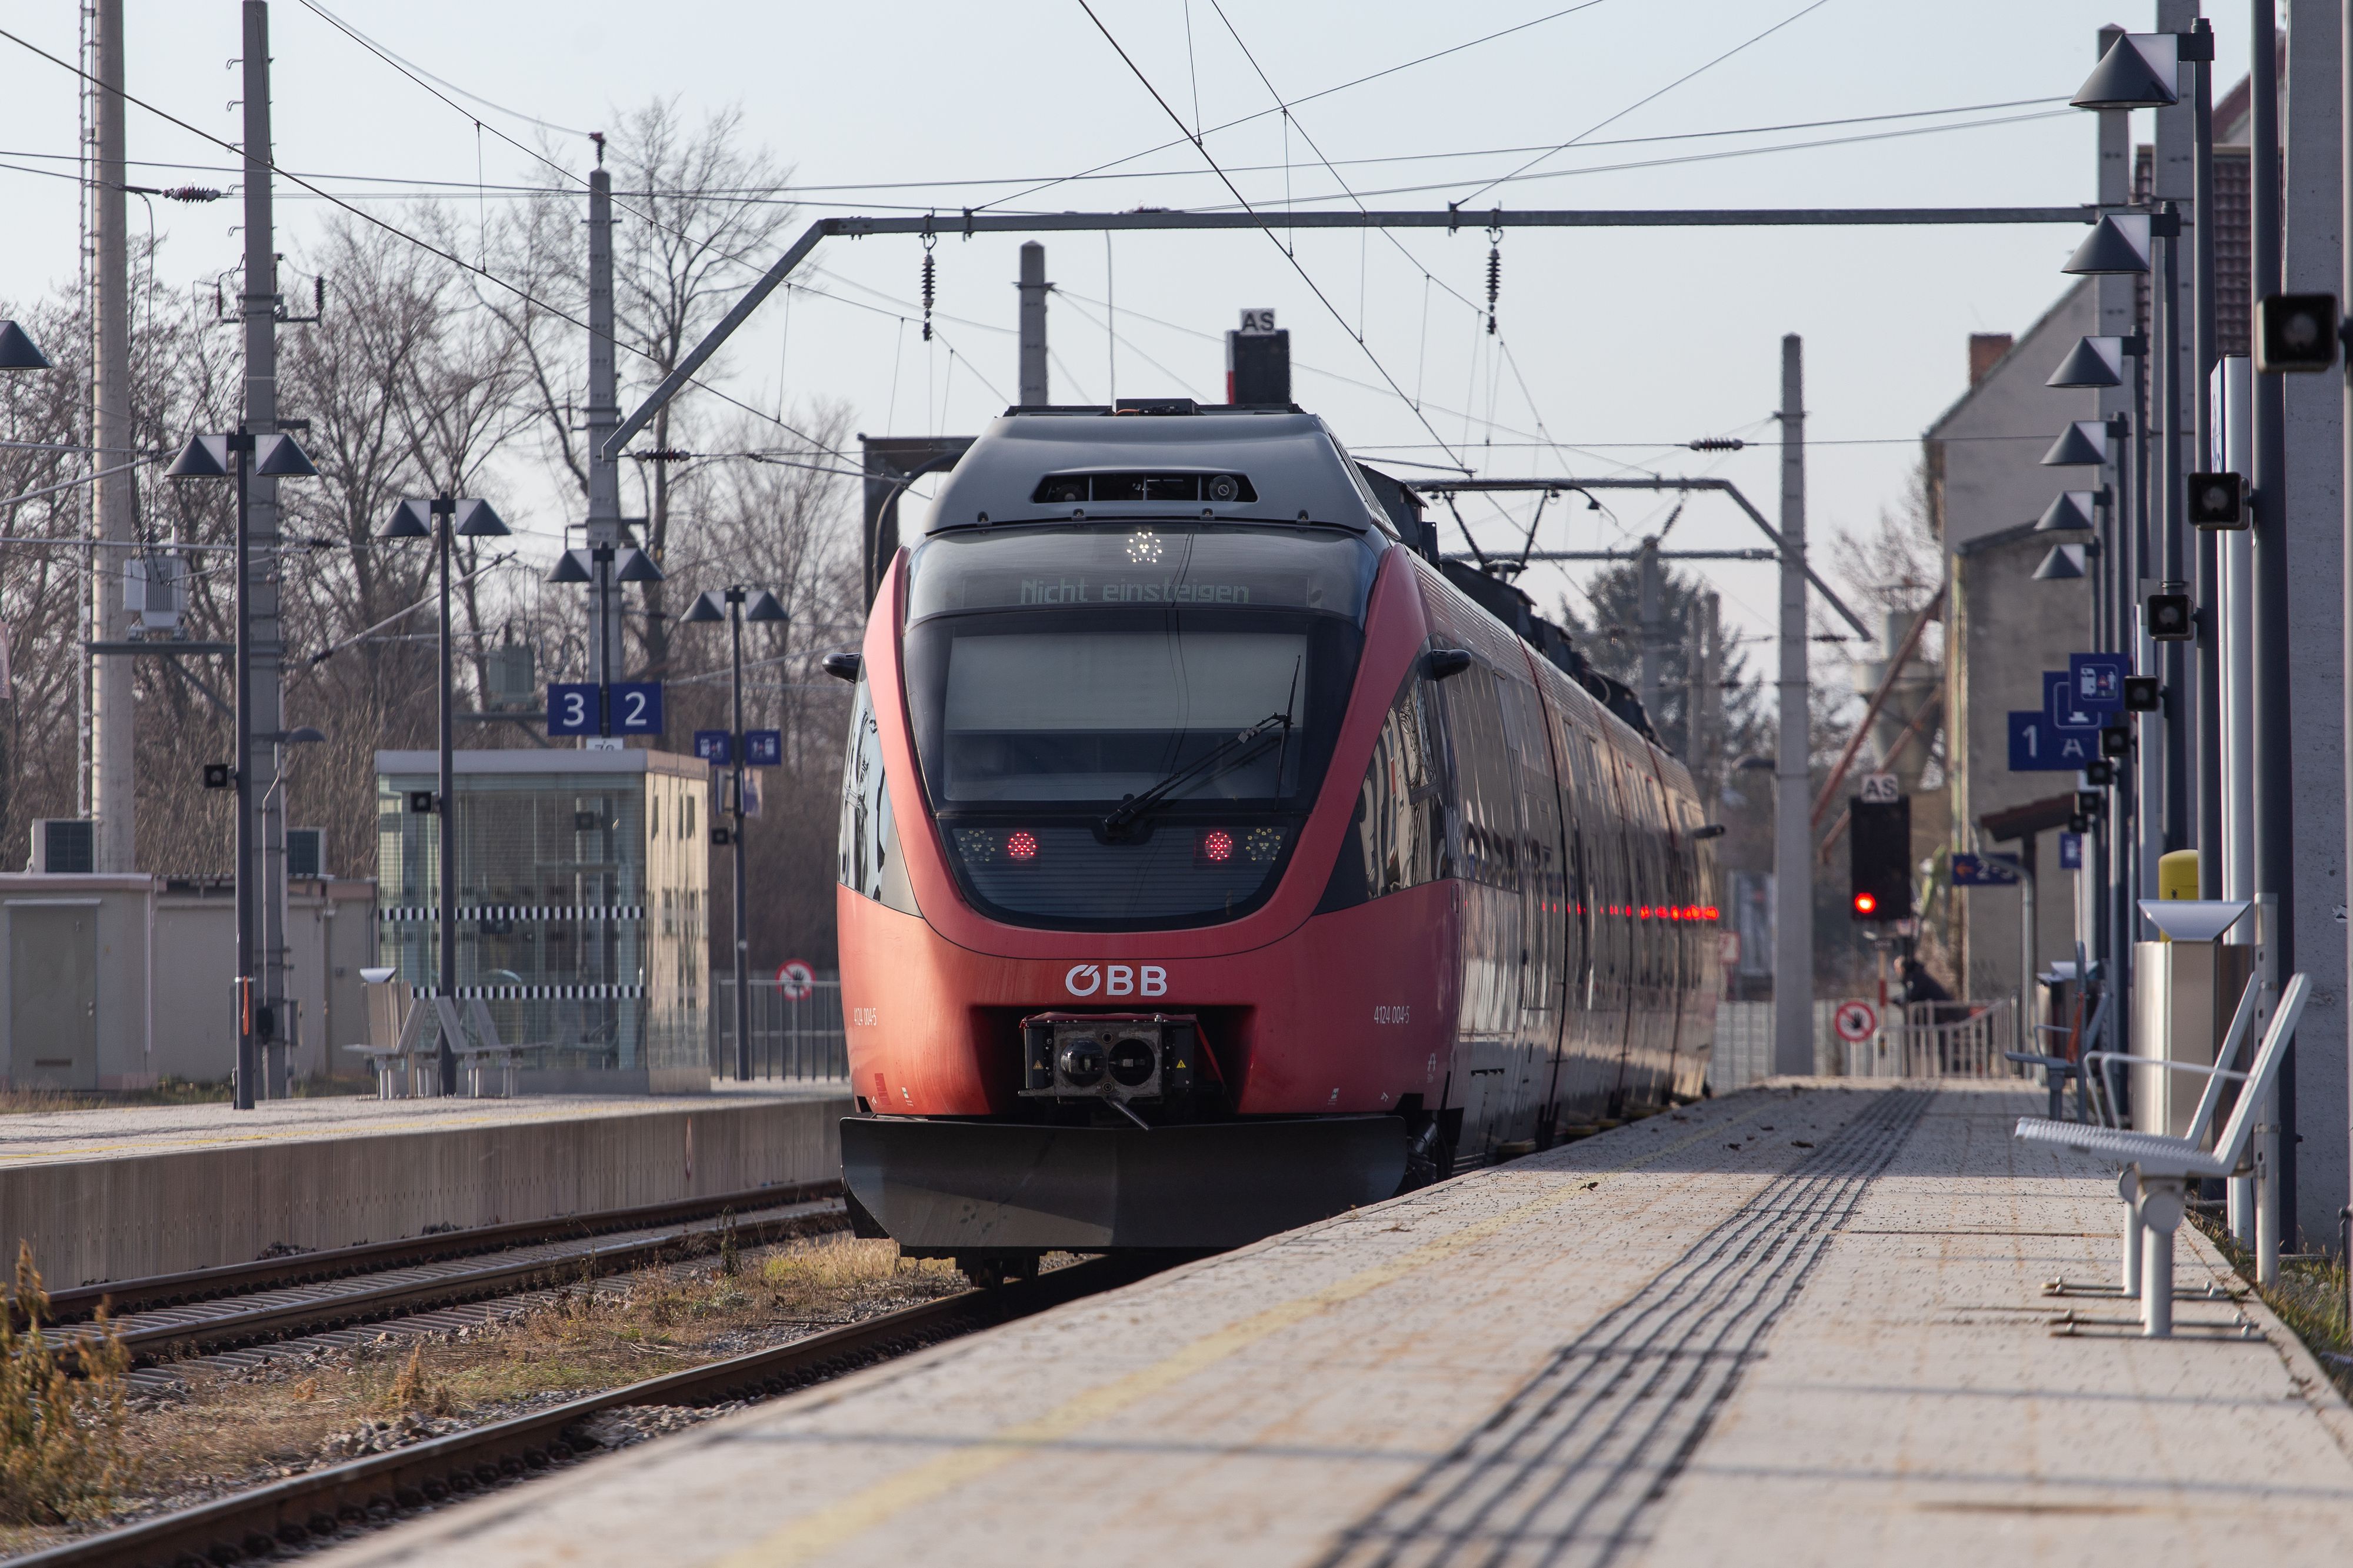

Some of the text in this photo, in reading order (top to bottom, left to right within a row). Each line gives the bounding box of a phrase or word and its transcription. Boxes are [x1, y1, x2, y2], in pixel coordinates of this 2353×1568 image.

[1241, 311, 1275, 331] AS
[1021, 576, 1249, 604] Nicht einsteigen
[562, 692, 585, 727] 3
[624, 691, 647, 726] 2
[2022, 724, 2037, 758] 1
[1864, 778, 1897, 798] AS
[1065, 964, 1167, 996] ÖBB
[1374, 1005, 1390, 1024] 4124
